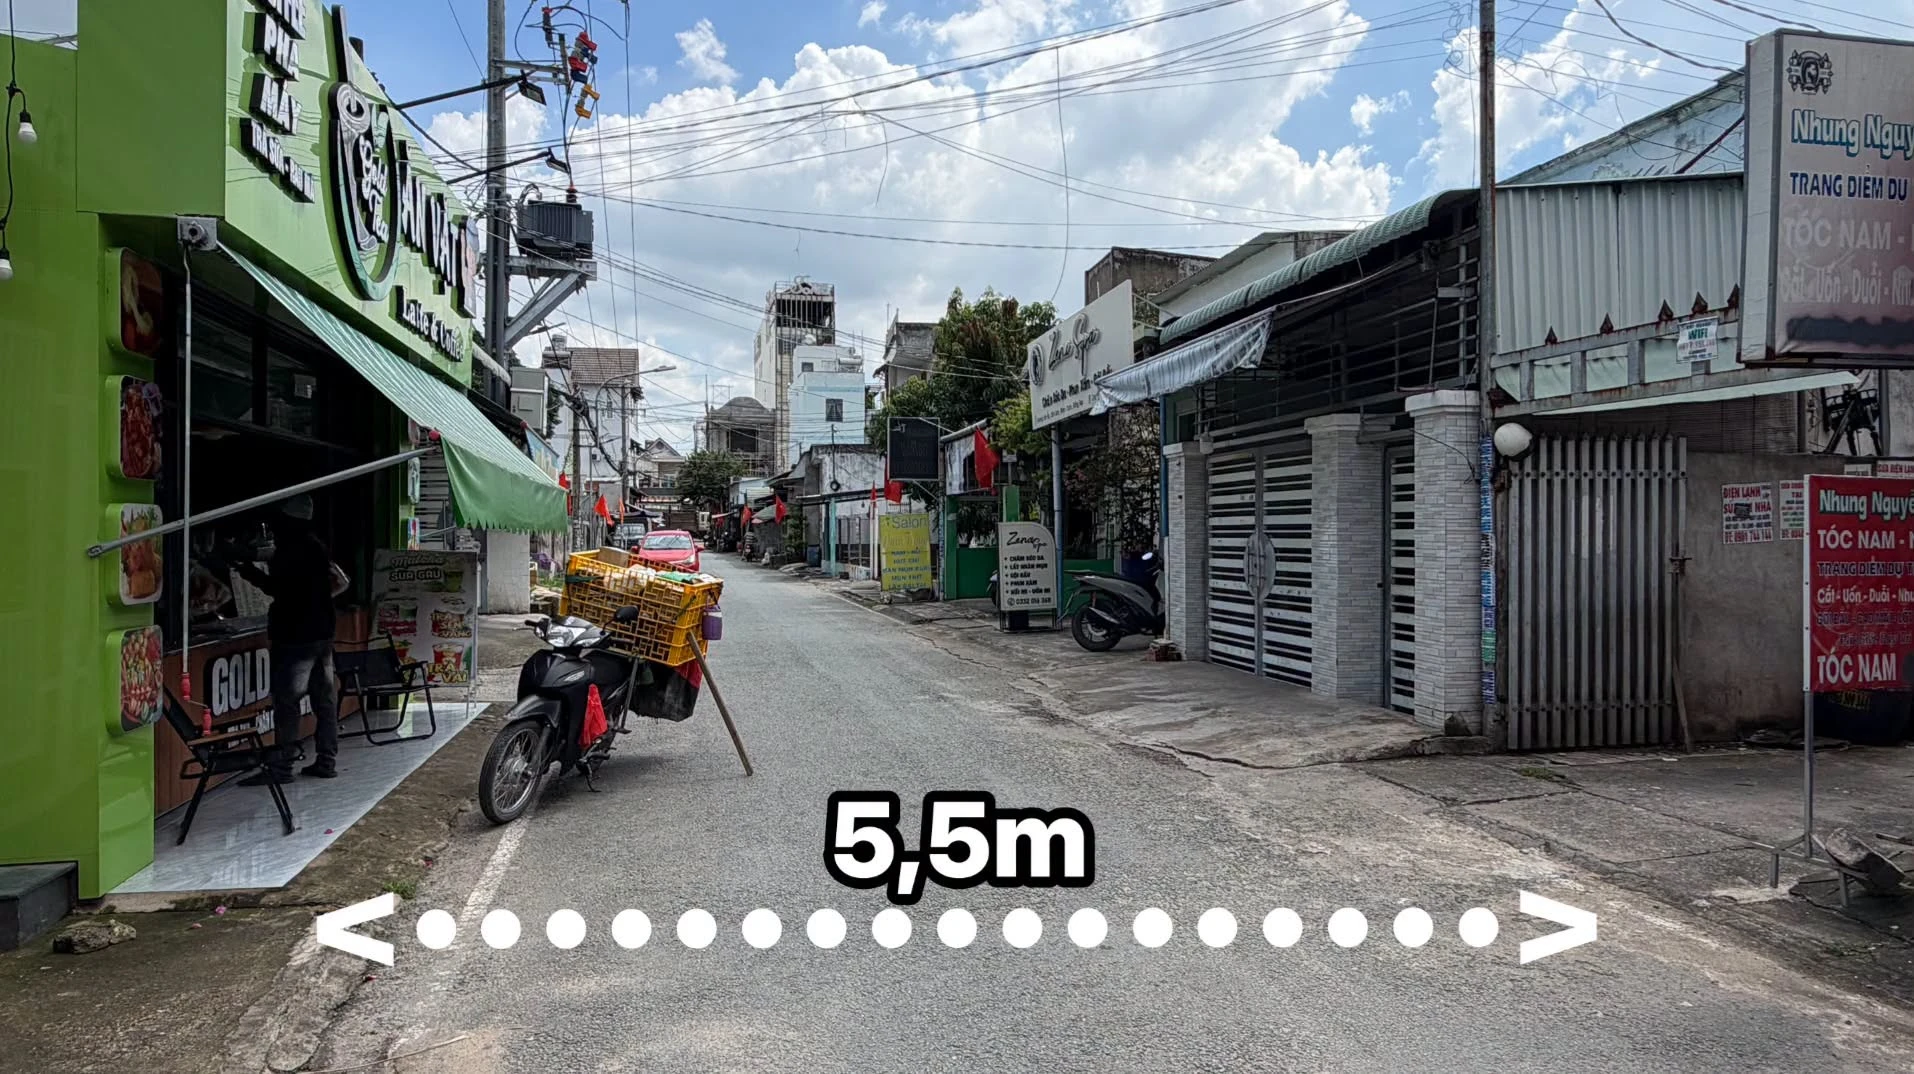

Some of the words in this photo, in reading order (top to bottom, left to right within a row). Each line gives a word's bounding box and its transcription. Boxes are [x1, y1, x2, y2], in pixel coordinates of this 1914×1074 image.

[263, 12, 300, 82] PHA
[259, 75, 304, 136] MÁY
[1791, 108, 1860, 158] Nhung
[1789, 171, 1844, 198] TRANG
[1783, 208, 1832, 250] TÓC
[1839, 219, 1892, 251] NAM
[402, 286, 430, 336] Latte
[1818, 489, 1868, 521] Nhung
[1817, 523, 1853, 550] TÓC
[1857, 530, 1896, 550] NAM
[1817, 561, 1857, 576] TRANG
[1842, 585, 1862, 603] Uốn
[212, 648, 271, 717] GOLD
[1817, 646, 1853, 684] TÓC
[1857, 653, 1897, 682] NAM
